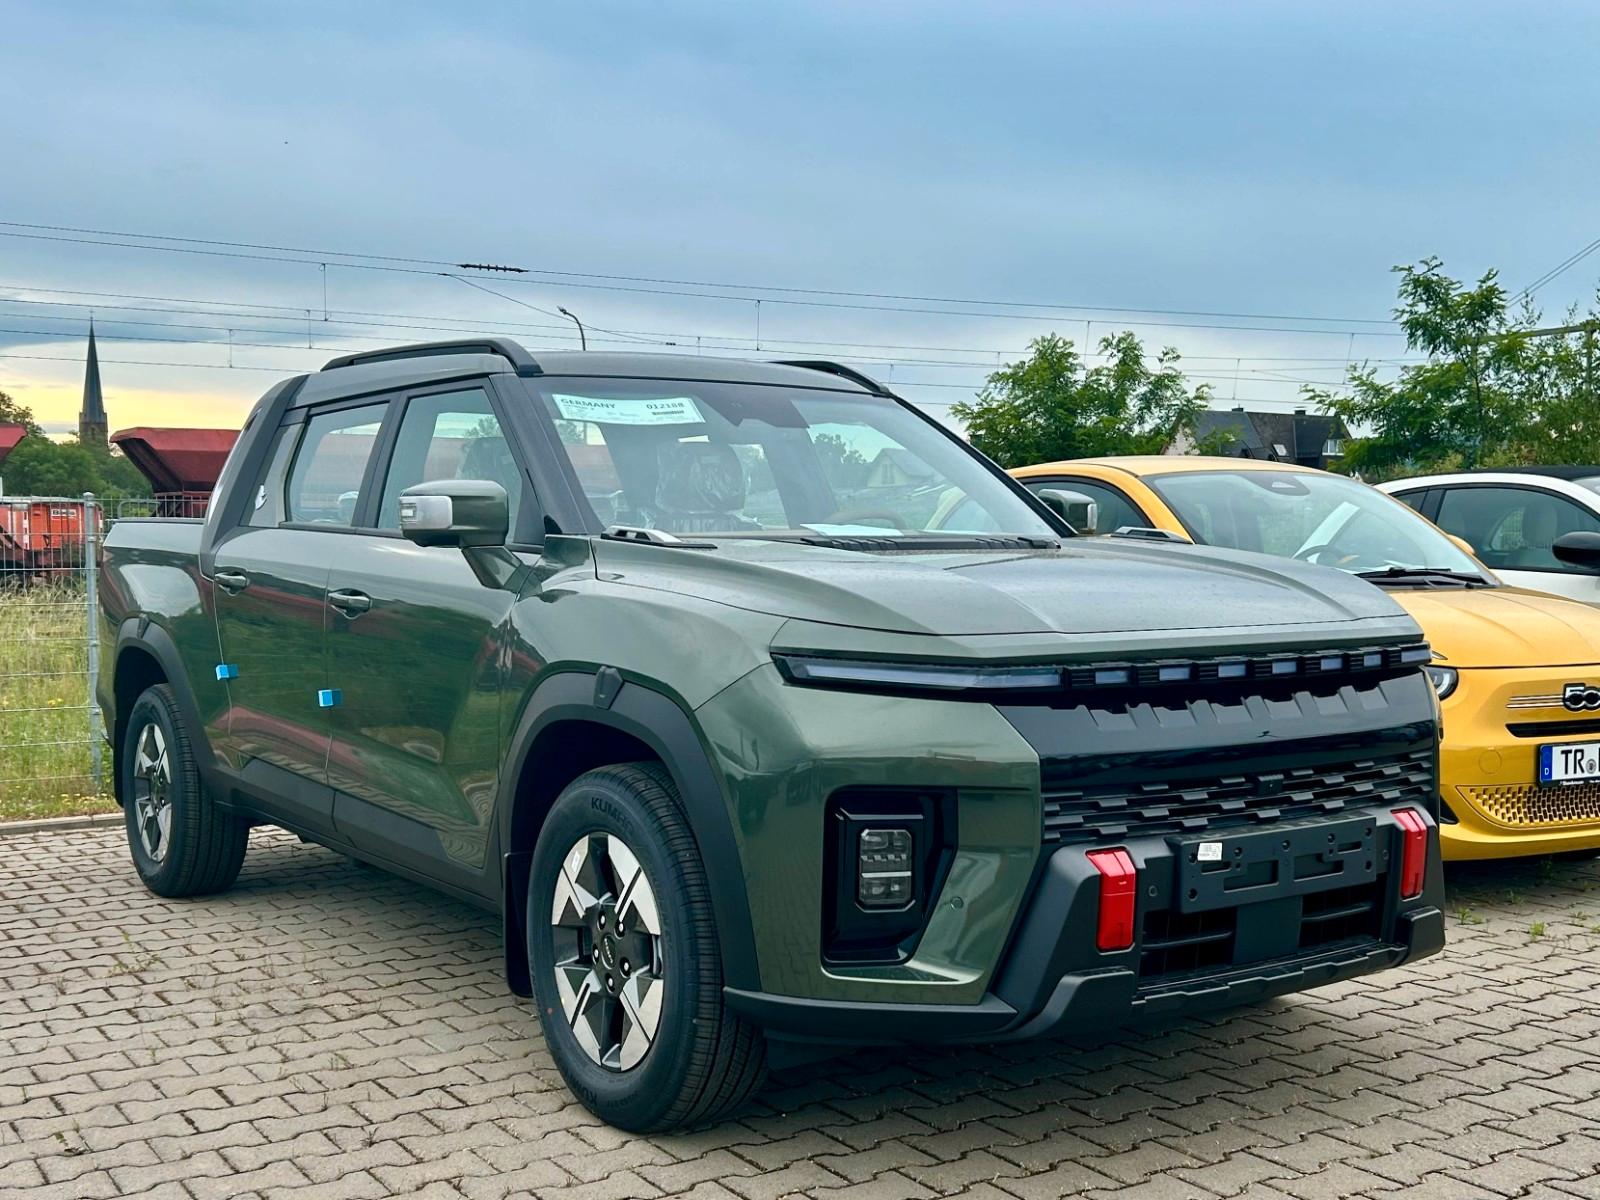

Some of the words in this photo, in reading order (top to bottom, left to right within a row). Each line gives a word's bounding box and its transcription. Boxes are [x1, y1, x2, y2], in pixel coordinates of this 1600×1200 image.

[560, 398, 616, 409] GERMANY
[1560, 749, 1585, 774] TR
[1544, 767, 1550, 775] D
